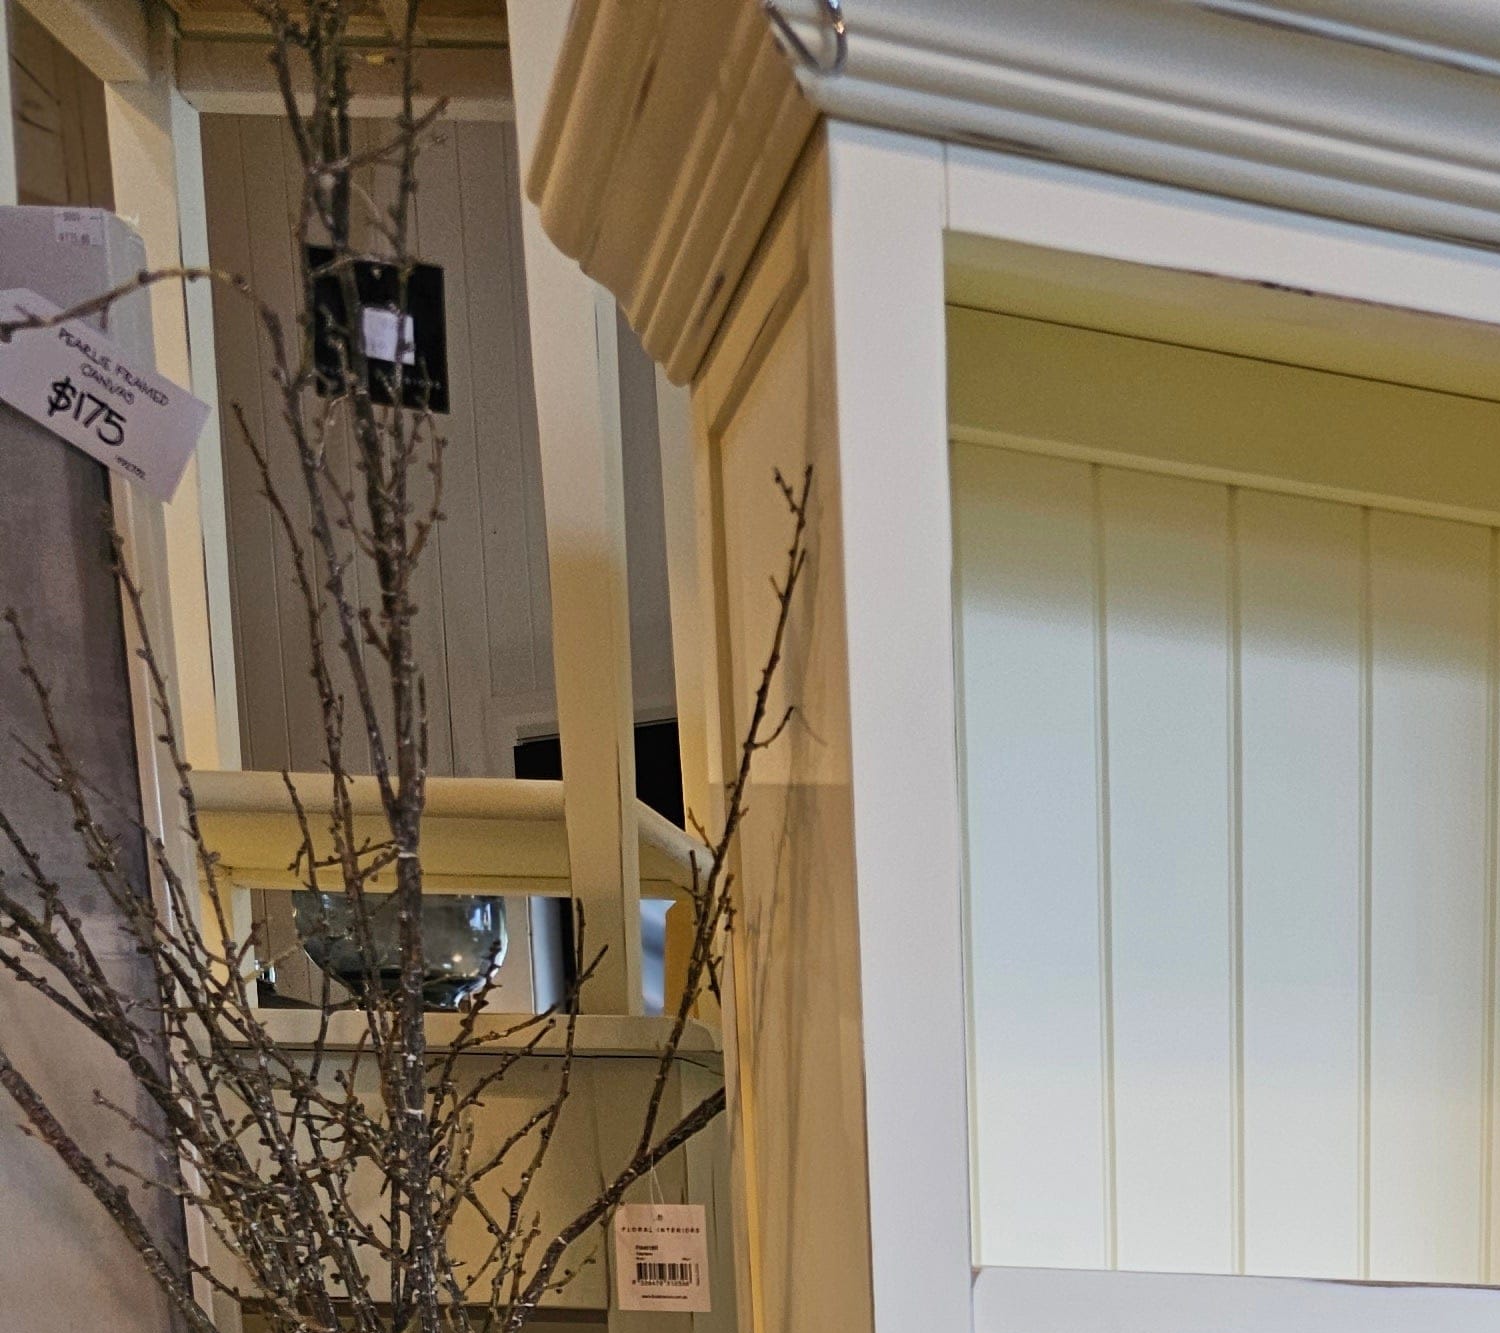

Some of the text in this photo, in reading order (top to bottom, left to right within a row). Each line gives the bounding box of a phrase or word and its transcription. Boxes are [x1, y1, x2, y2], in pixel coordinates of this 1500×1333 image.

[80, 362, 135, 405] CANVAS
[115, 364, 169, 406] FRAMED
[47, 376, 126, 446] $175
